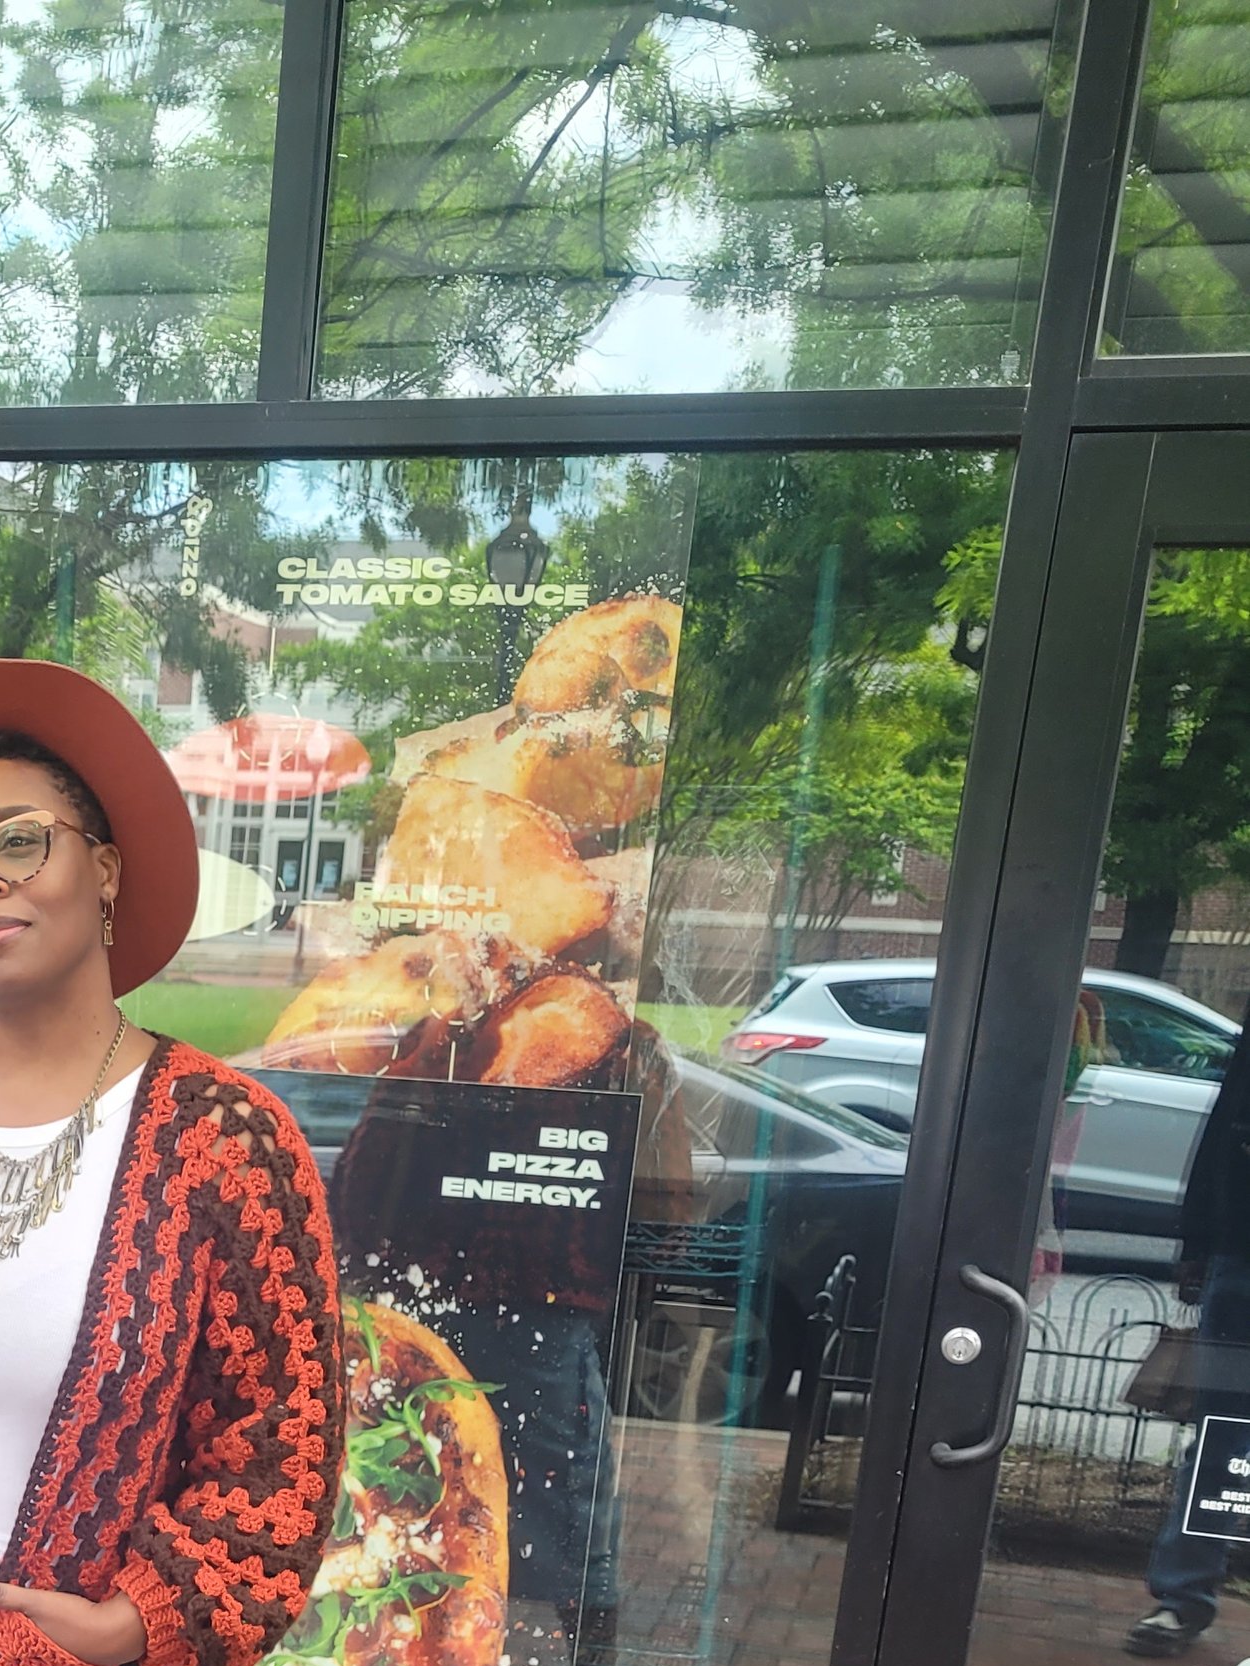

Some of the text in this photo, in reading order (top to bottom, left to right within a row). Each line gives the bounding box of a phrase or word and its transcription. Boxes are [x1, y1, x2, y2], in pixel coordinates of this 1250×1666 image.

[180, 495, 213, 597] &pizza
[276, 556, 452, 581] CLASSIC
[276, 584, 590, 607] TOMATO SAUCE
[353, 880, 496, 908] RANCH
[352, 902, 512, 933] DIPPING
[538, 1126, 609, 1152] BIG
[487, 1151, 605, 1181] PIZZA
[440, 1175, 601, 1210] ENERGY.
[1198, 1499, 1232, 1512] BEST
